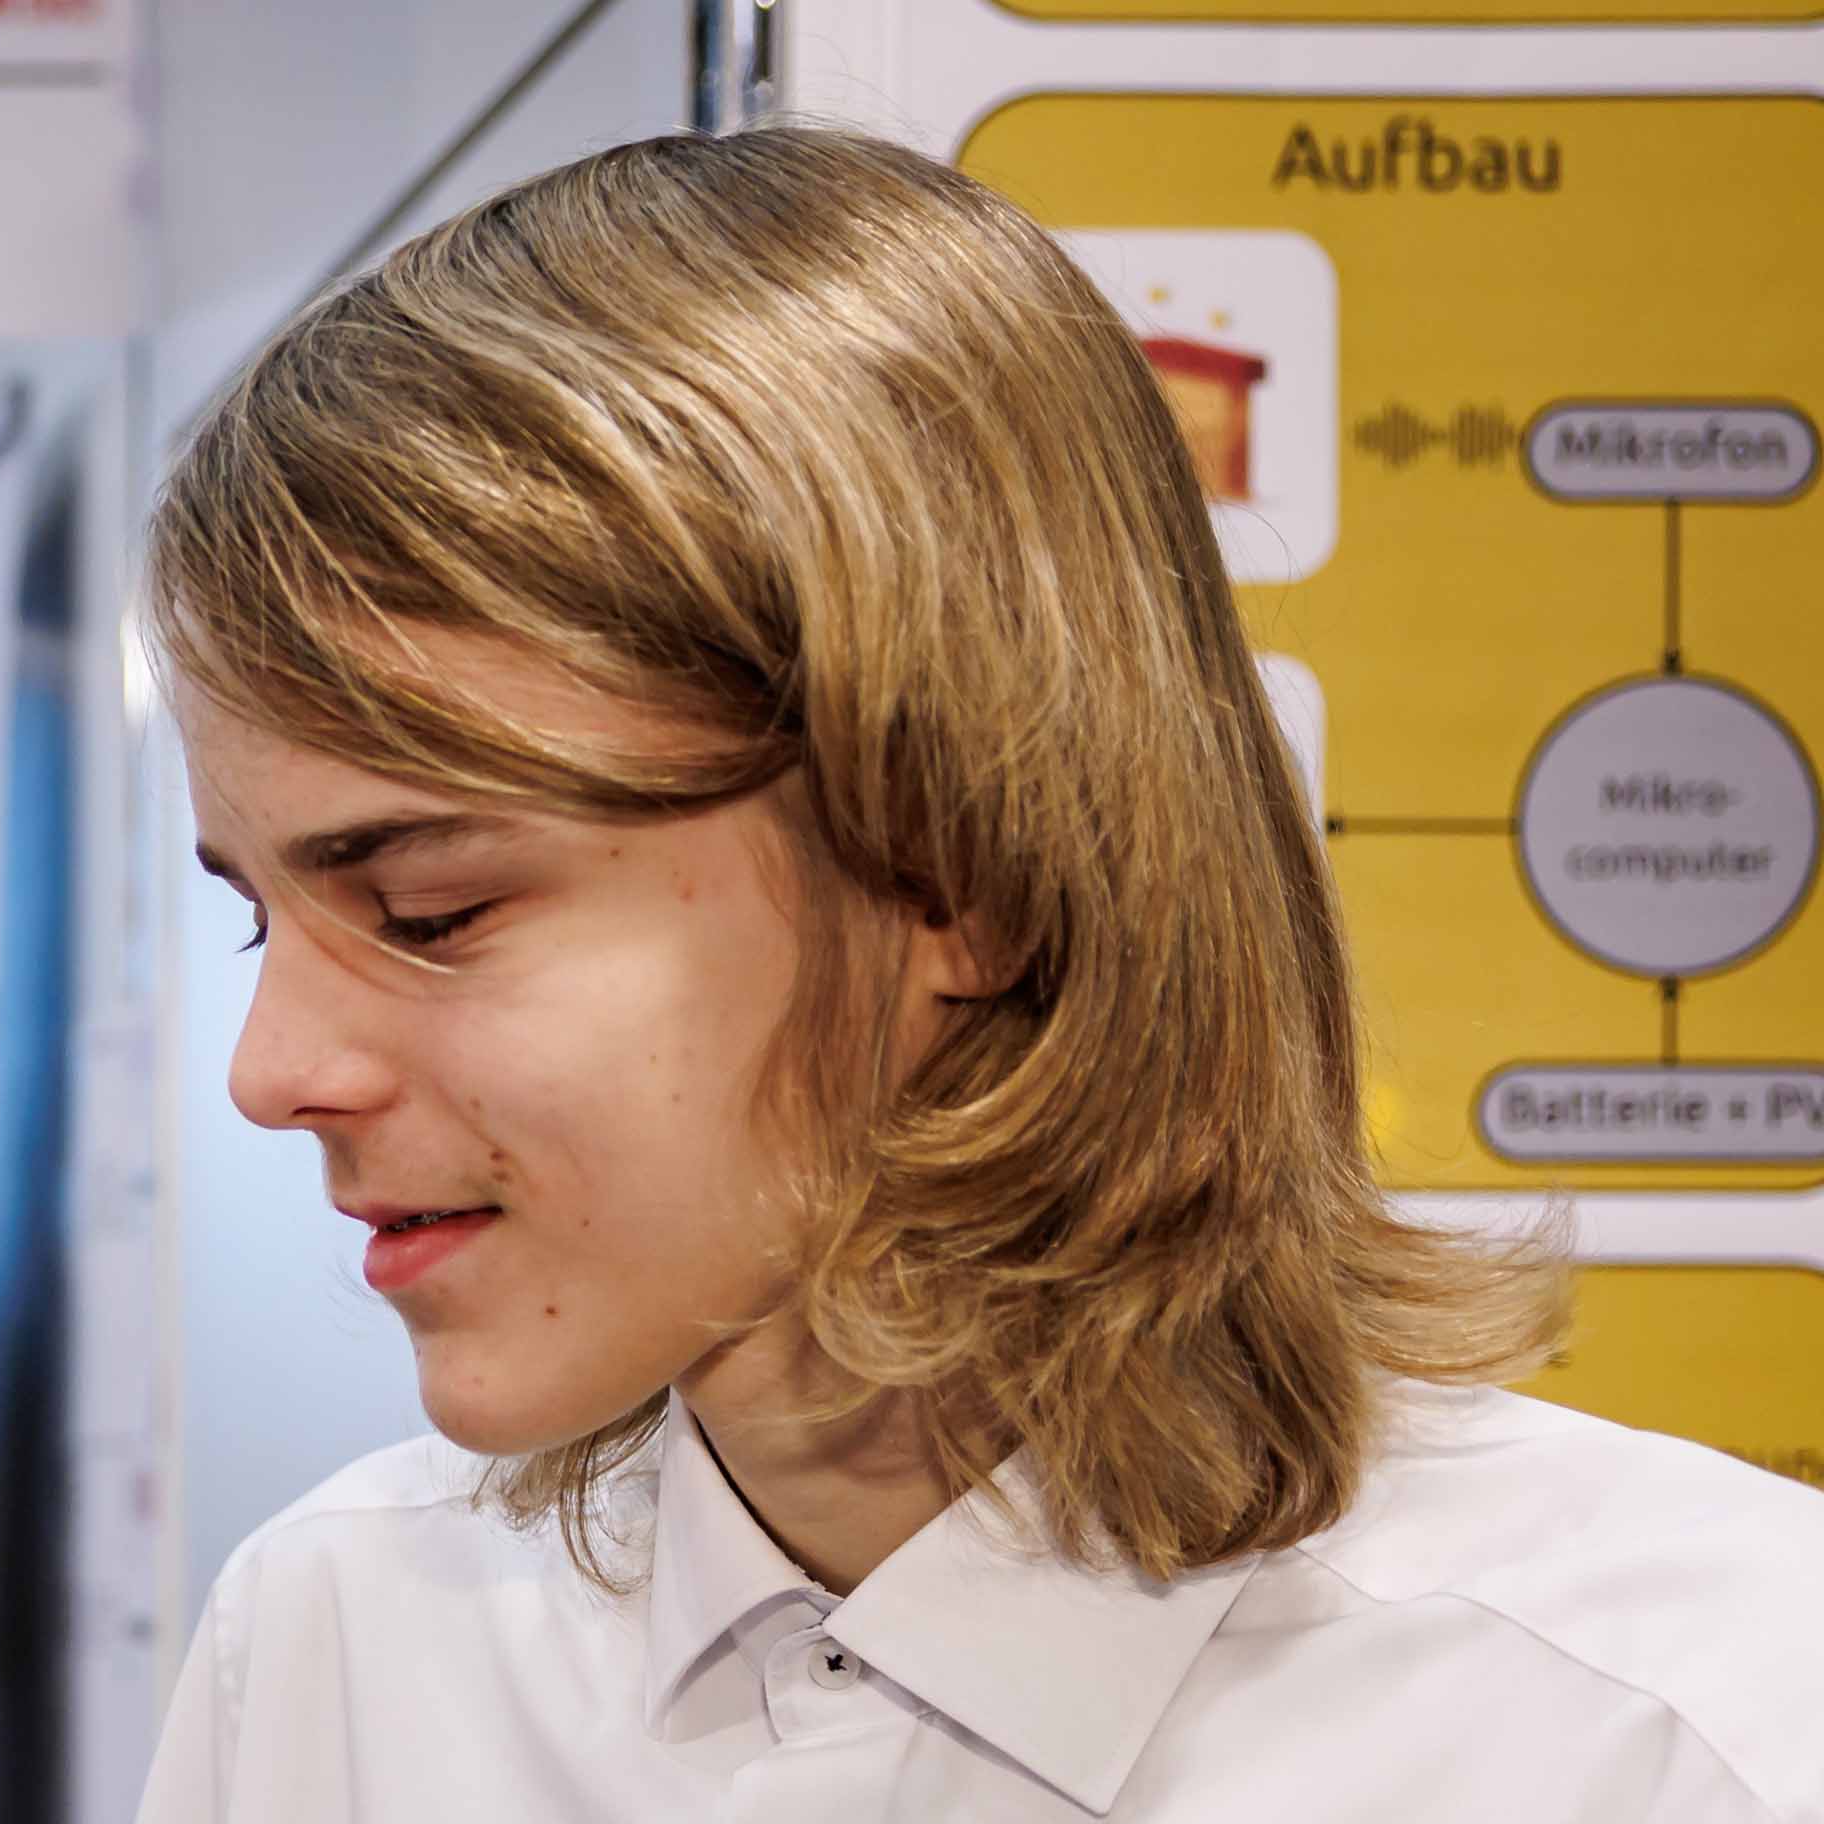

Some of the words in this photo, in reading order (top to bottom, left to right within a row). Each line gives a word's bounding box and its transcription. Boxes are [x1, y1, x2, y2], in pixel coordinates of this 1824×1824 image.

[1269, 114, 1561, 193] Aufbau
[1556, 416, 1789, 470] Mikrofon
[1564, 840, 1776, 884] computer
[1501, 1080, 1710, 1134] Batterie
